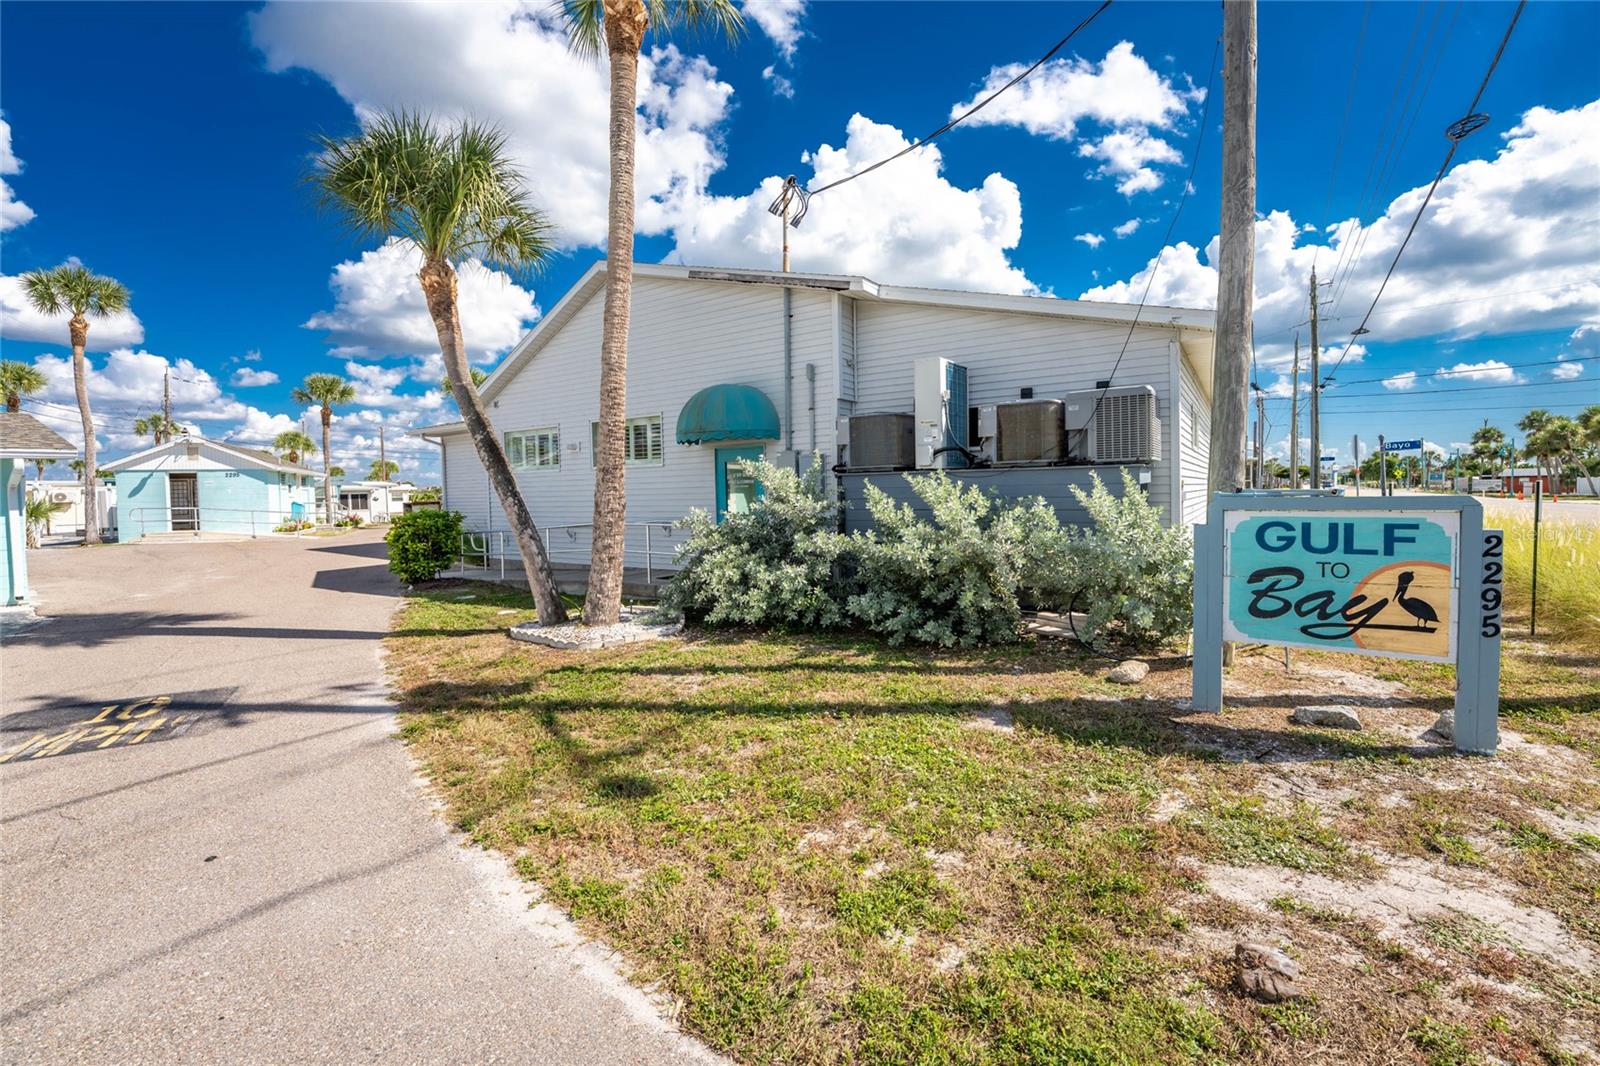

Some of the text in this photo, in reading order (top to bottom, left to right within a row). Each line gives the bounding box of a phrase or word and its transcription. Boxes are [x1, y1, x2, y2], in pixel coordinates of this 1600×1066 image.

[1385, 441, 1411, 450] Bayo
[1255, 521, 1420, 556] GULF
[1316, 561, 1350, 579] TO
[1480, 534, 1503, 639] 2295
[1247, 566, 1437, 640] Bay
[78, 696, 172, 725] 10
